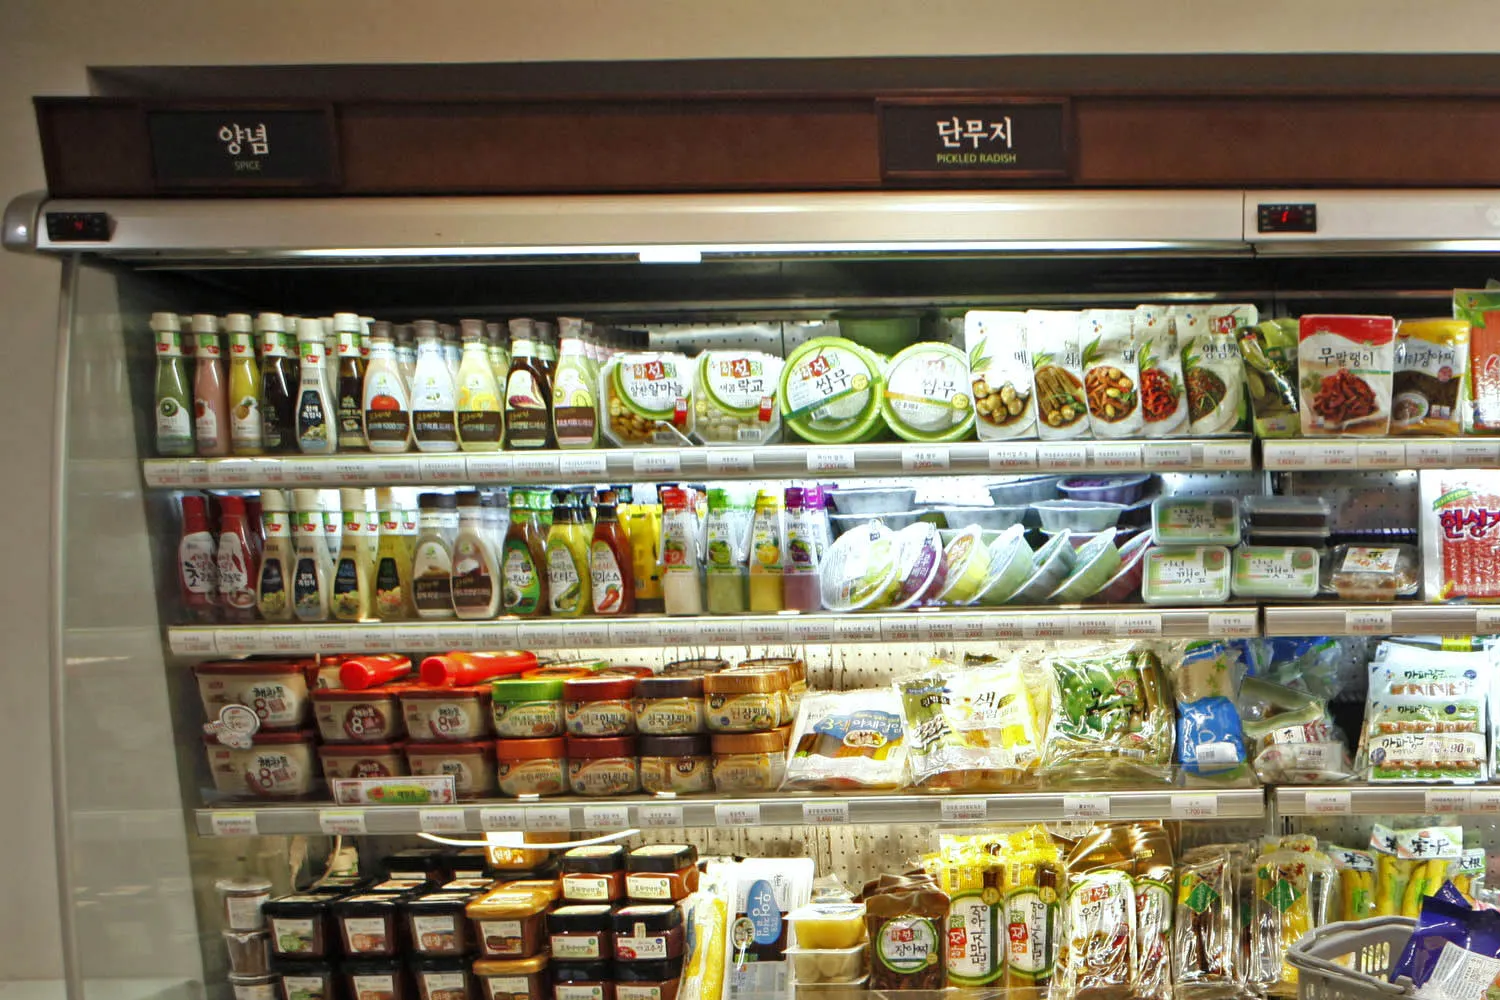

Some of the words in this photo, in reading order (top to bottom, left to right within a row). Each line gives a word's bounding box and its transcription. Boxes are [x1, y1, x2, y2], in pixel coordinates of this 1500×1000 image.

[219, 123, 269, 155] 양념
[936, 116, 1012, 149] 단무지
[936, 153, 977, 164] PICKLED
[980, 153, 1016, 164] RADISH
[1318, 346, 1375, 369] 무말랭이
